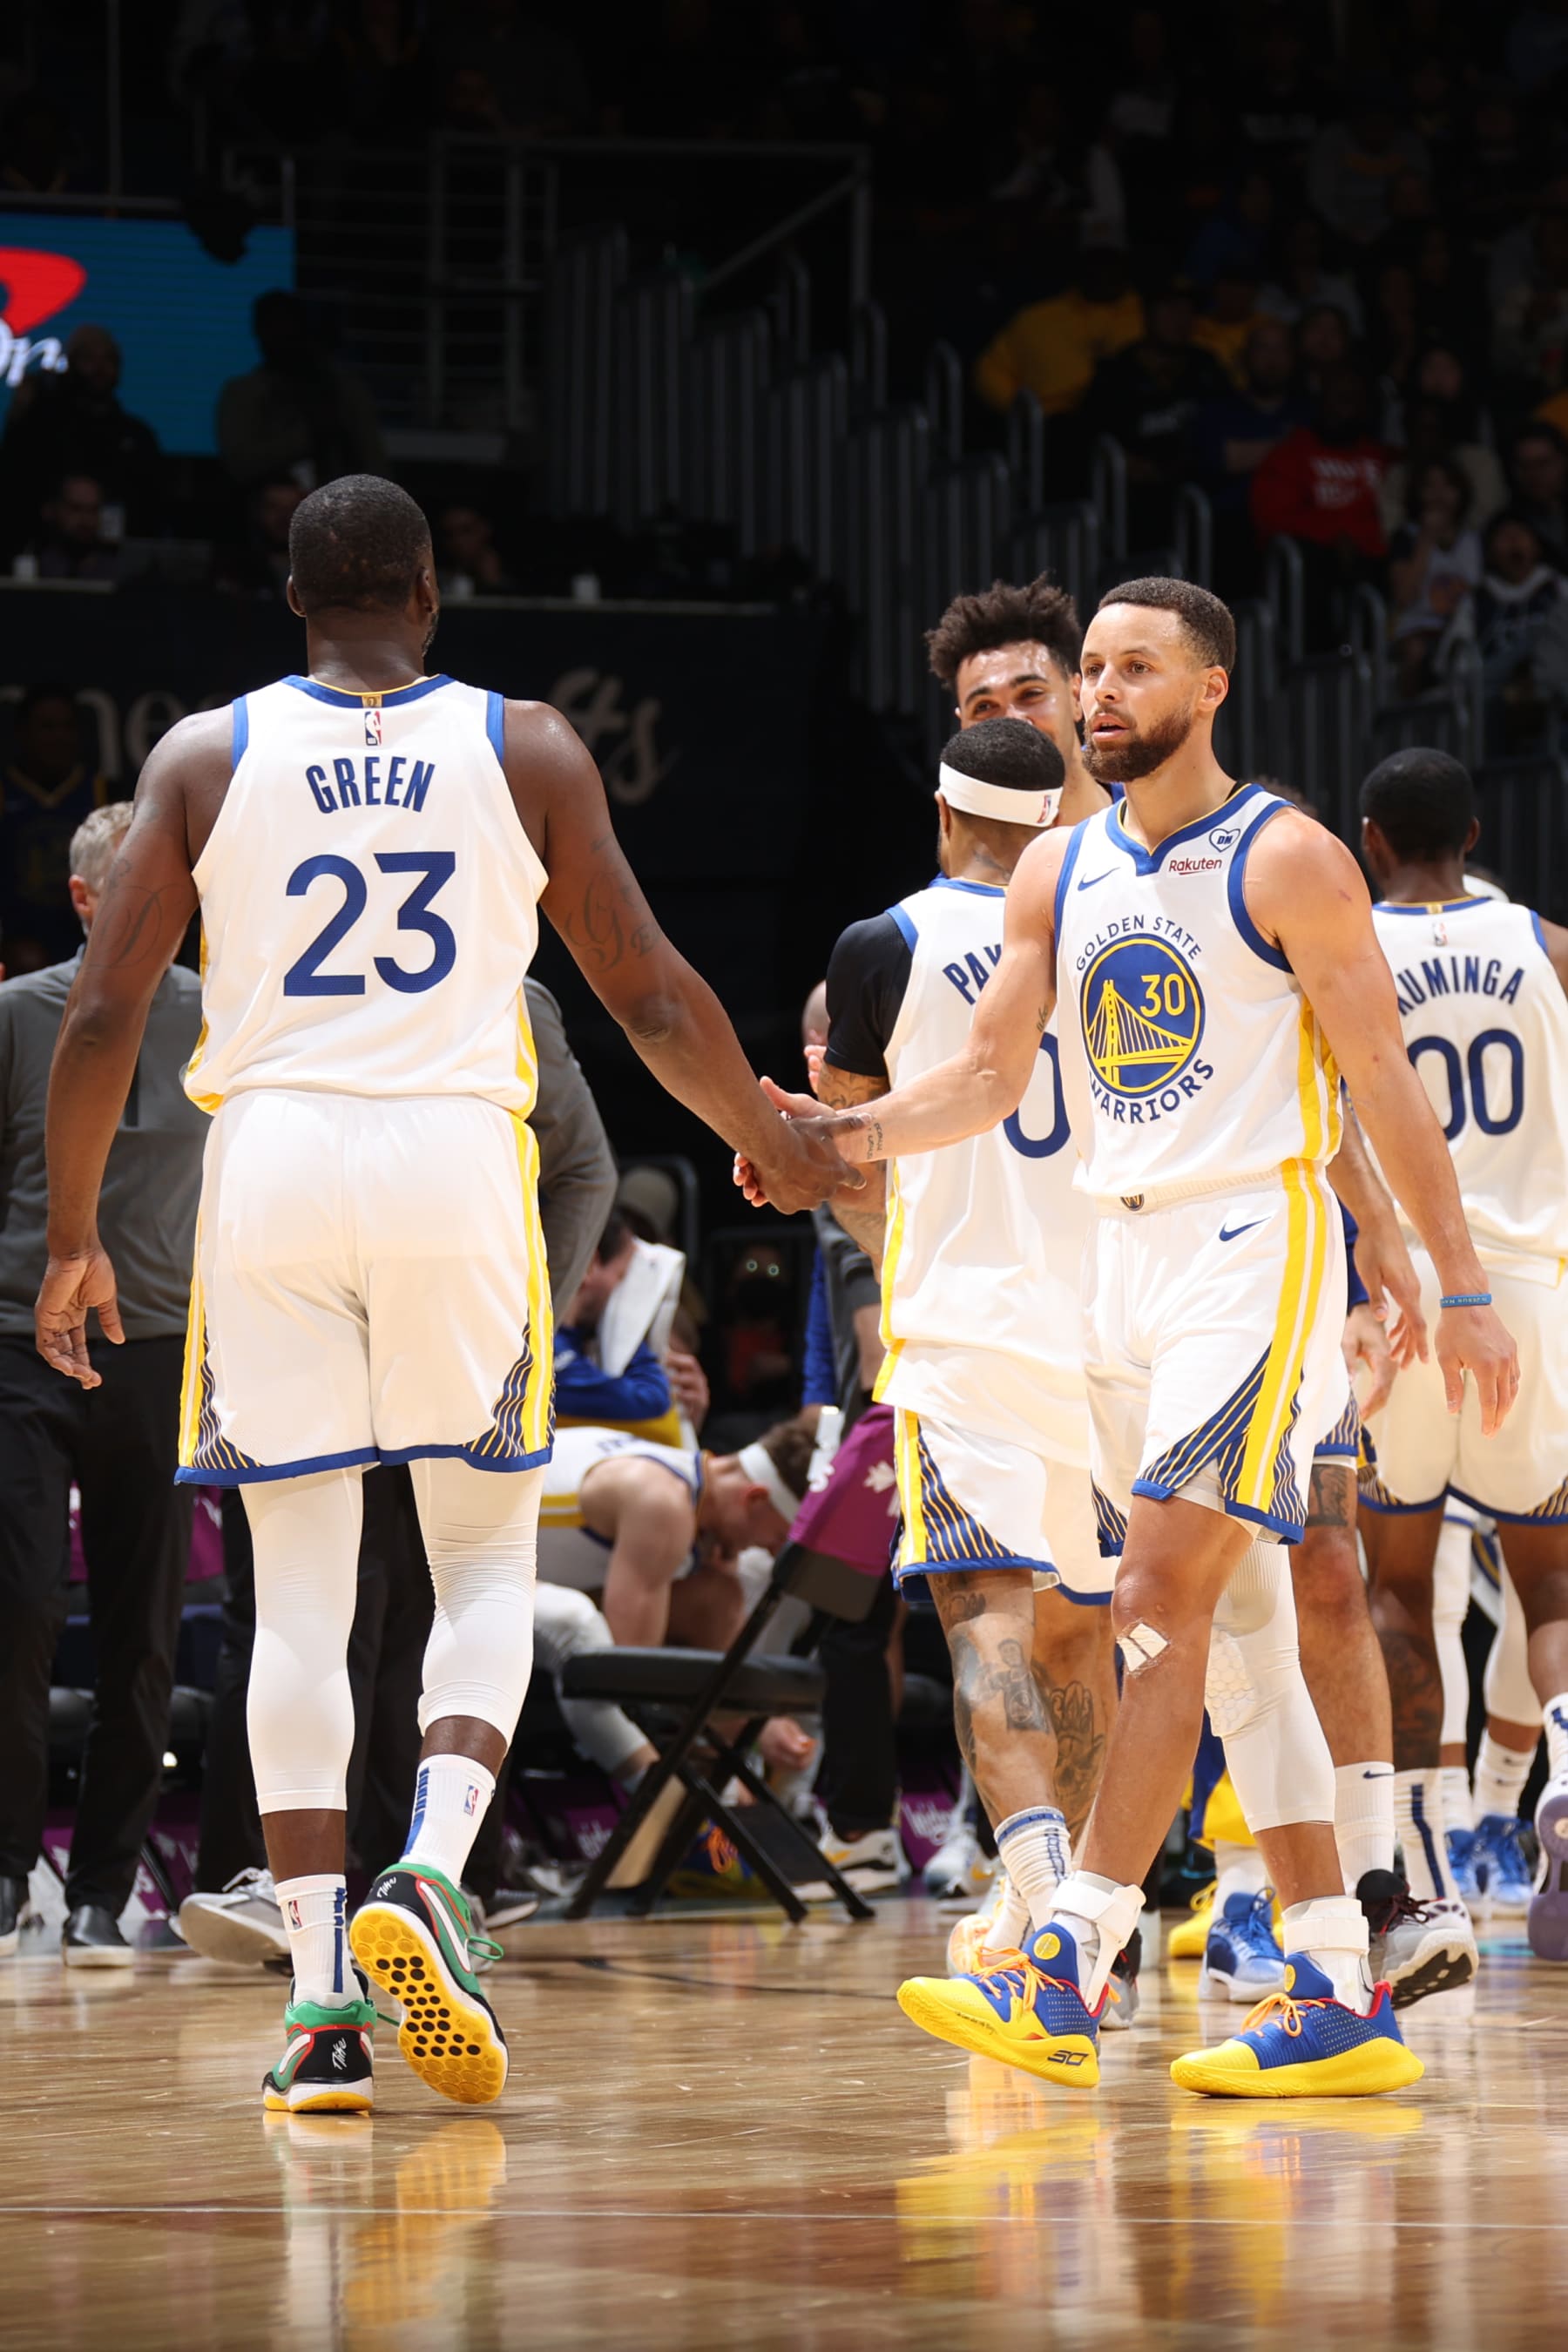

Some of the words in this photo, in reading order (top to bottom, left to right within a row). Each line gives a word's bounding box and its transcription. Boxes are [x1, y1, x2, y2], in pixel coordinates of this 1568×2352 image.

[306, 756, 436, 814] GREEN
[1168, 857, 1222, 872] Rakuten
[283, 851, 456, 997] 23
[1077, 915, 1145, 971] GOLDEN
[1152, 916, 1202, 960] STATE
[1139, 973, 1186, 1017] 30
[1089, 1058, 1214, 1124] WARRIORS
[1406, 1028, 1524, 1141] 00
